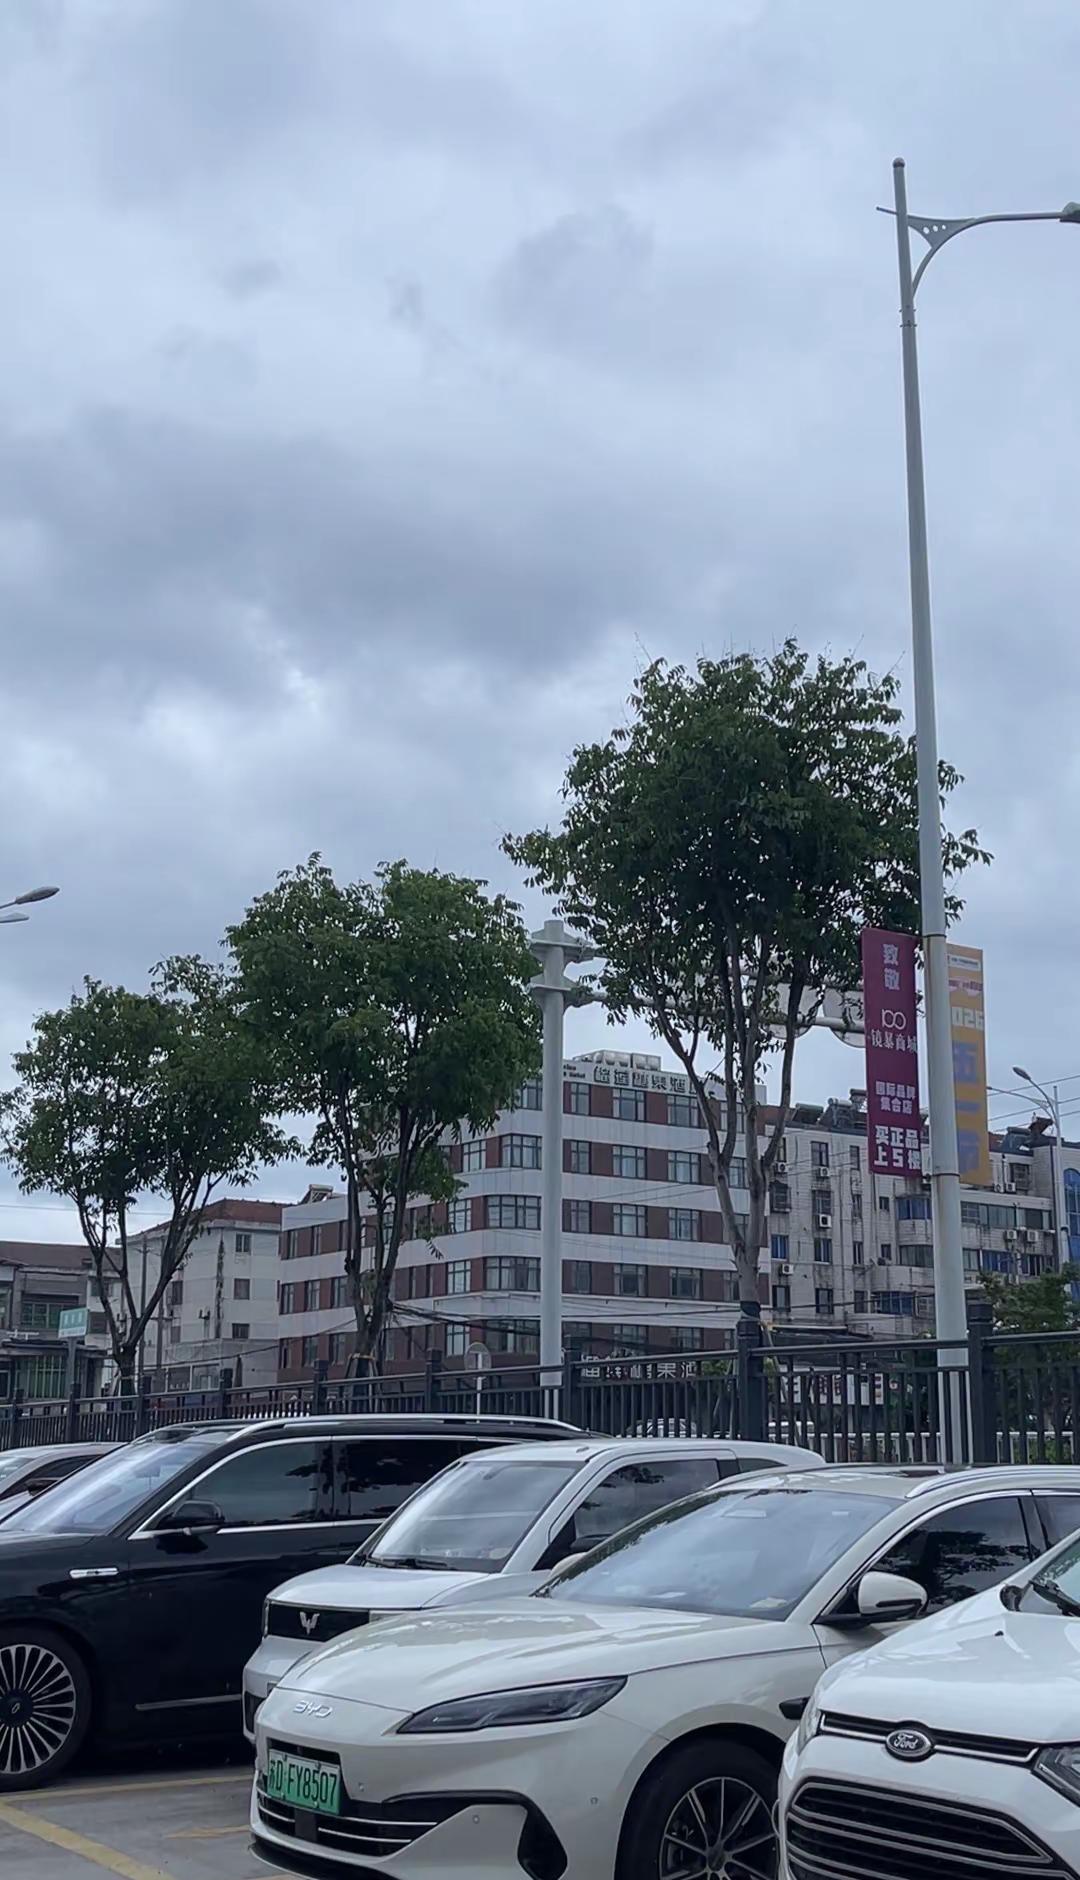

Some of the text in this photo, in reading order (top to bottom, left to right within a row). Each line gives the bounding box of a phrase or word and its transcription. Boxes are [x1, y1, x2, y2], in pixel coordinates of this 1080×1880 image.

[876, 1081, 915, 1100] 国际品牌
[880, 1096, 912, 1114] 集合店
[875, 1125, 919, 1149] 买正品
[874, 1146, 920, 1170] 上5楼
[292, 1699, 333, 1718] BYD
[893, 1733, 918, 1749] Ford
